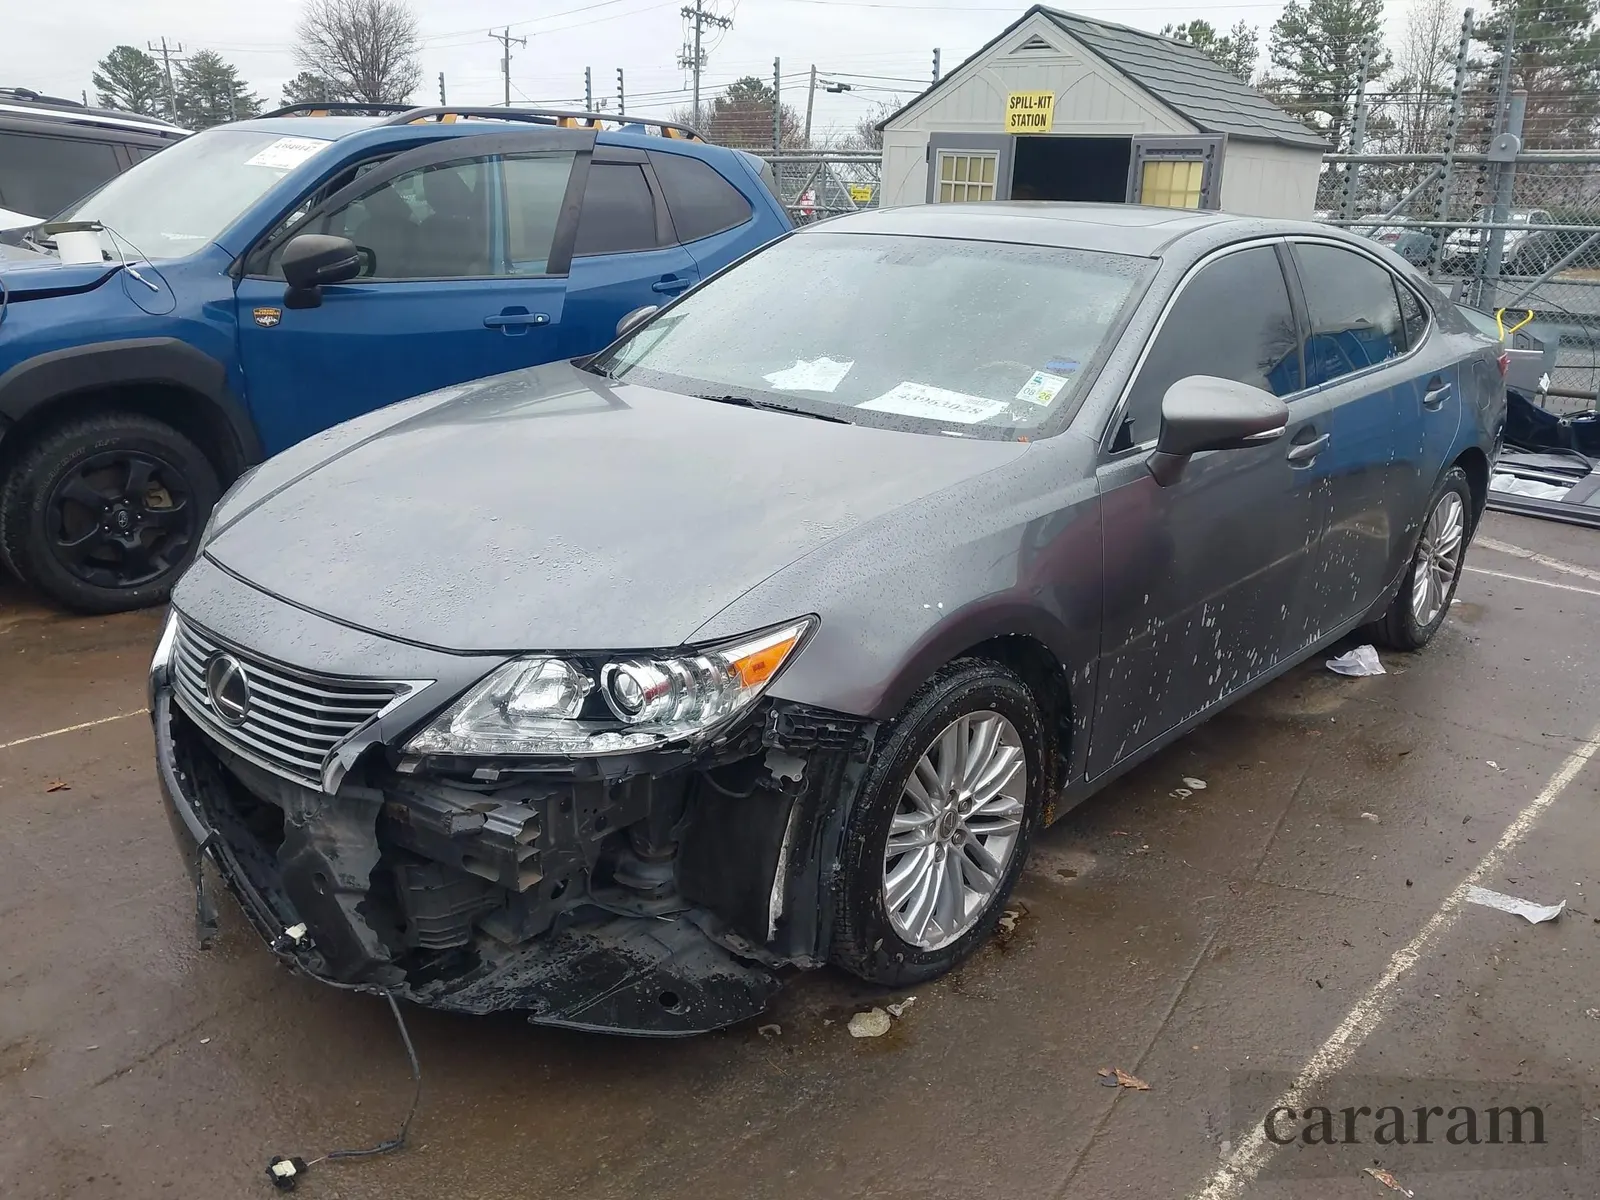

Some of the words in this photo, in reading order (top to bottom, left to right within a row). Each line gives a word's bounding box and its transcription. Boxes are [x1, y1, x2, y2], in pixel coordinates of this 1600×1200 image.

[1010, 96, 1052, 109] SPILL-KIT
[1011, 114, 1047, 126] STATION
[1039, 392, 1052, 401] 26
